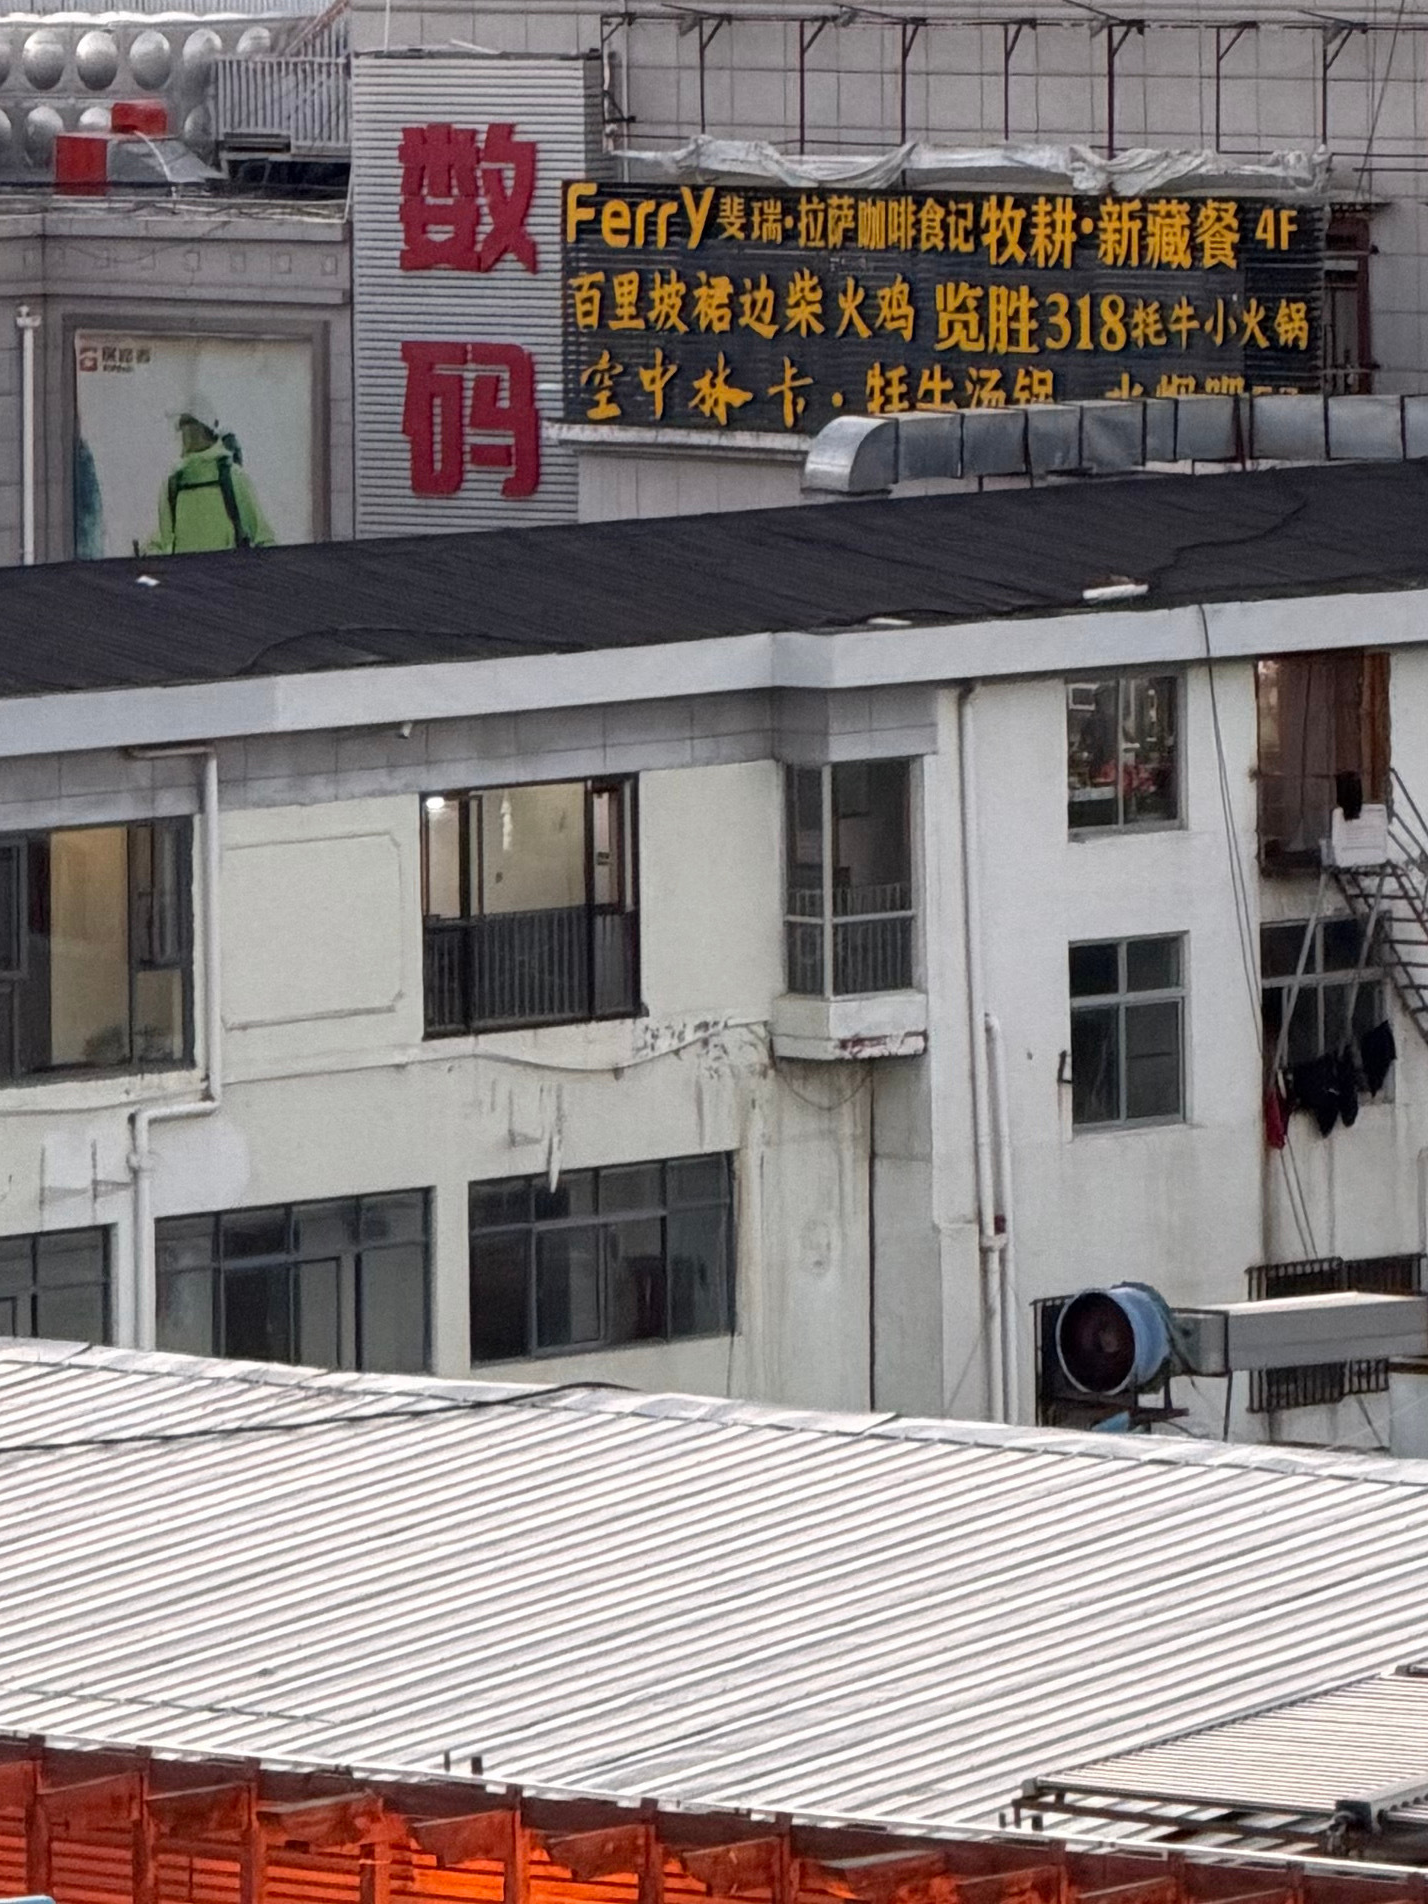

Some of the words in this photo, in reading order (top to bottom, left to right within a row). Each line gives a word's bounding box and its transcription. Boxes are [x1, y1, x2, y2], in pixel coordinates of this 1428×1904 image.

[1255, 208, 1299, 250] 4F
[398, 123, 540, 497] 数码
[569, 268, 915, 342] 百里坡裙边柴火鸡
